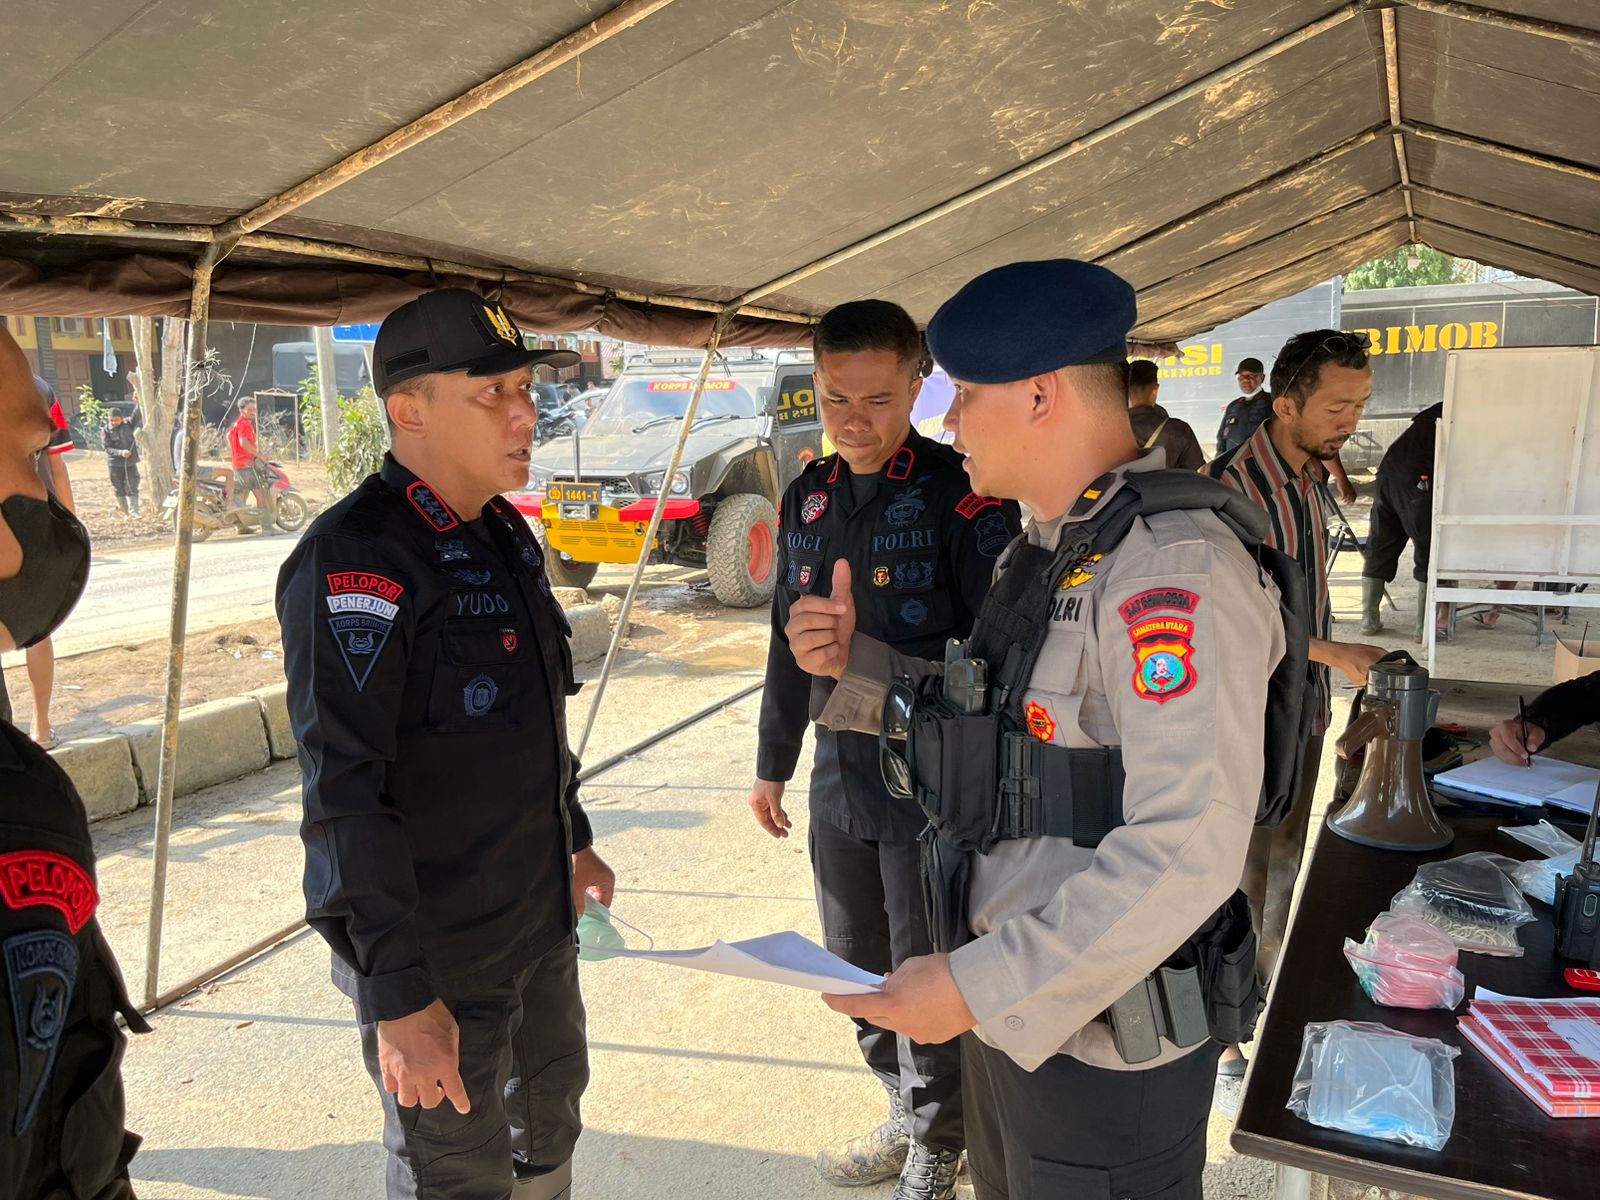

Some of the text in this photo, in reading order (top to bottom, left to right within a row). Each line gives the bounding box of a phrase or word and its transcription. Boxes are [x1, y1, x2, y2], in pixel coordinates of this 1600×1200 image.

[1342, 321, 1498, 356] RIMOB
[1157, 365, 1222, 379] RIMOB
[653, 382, 687, 391] KORPS
[565, 489, 598, 502] 1441-I
[873, 529, 936, 552] POLRI
[333, 575, 398, 598] PELOPOR
[332, 597, 394, 616] PENERJUN
[456, 593, 510, 615] YUDO
[1048, 597, 1084, 622] OLRI
[335, 618, 360, 630] KORPS
